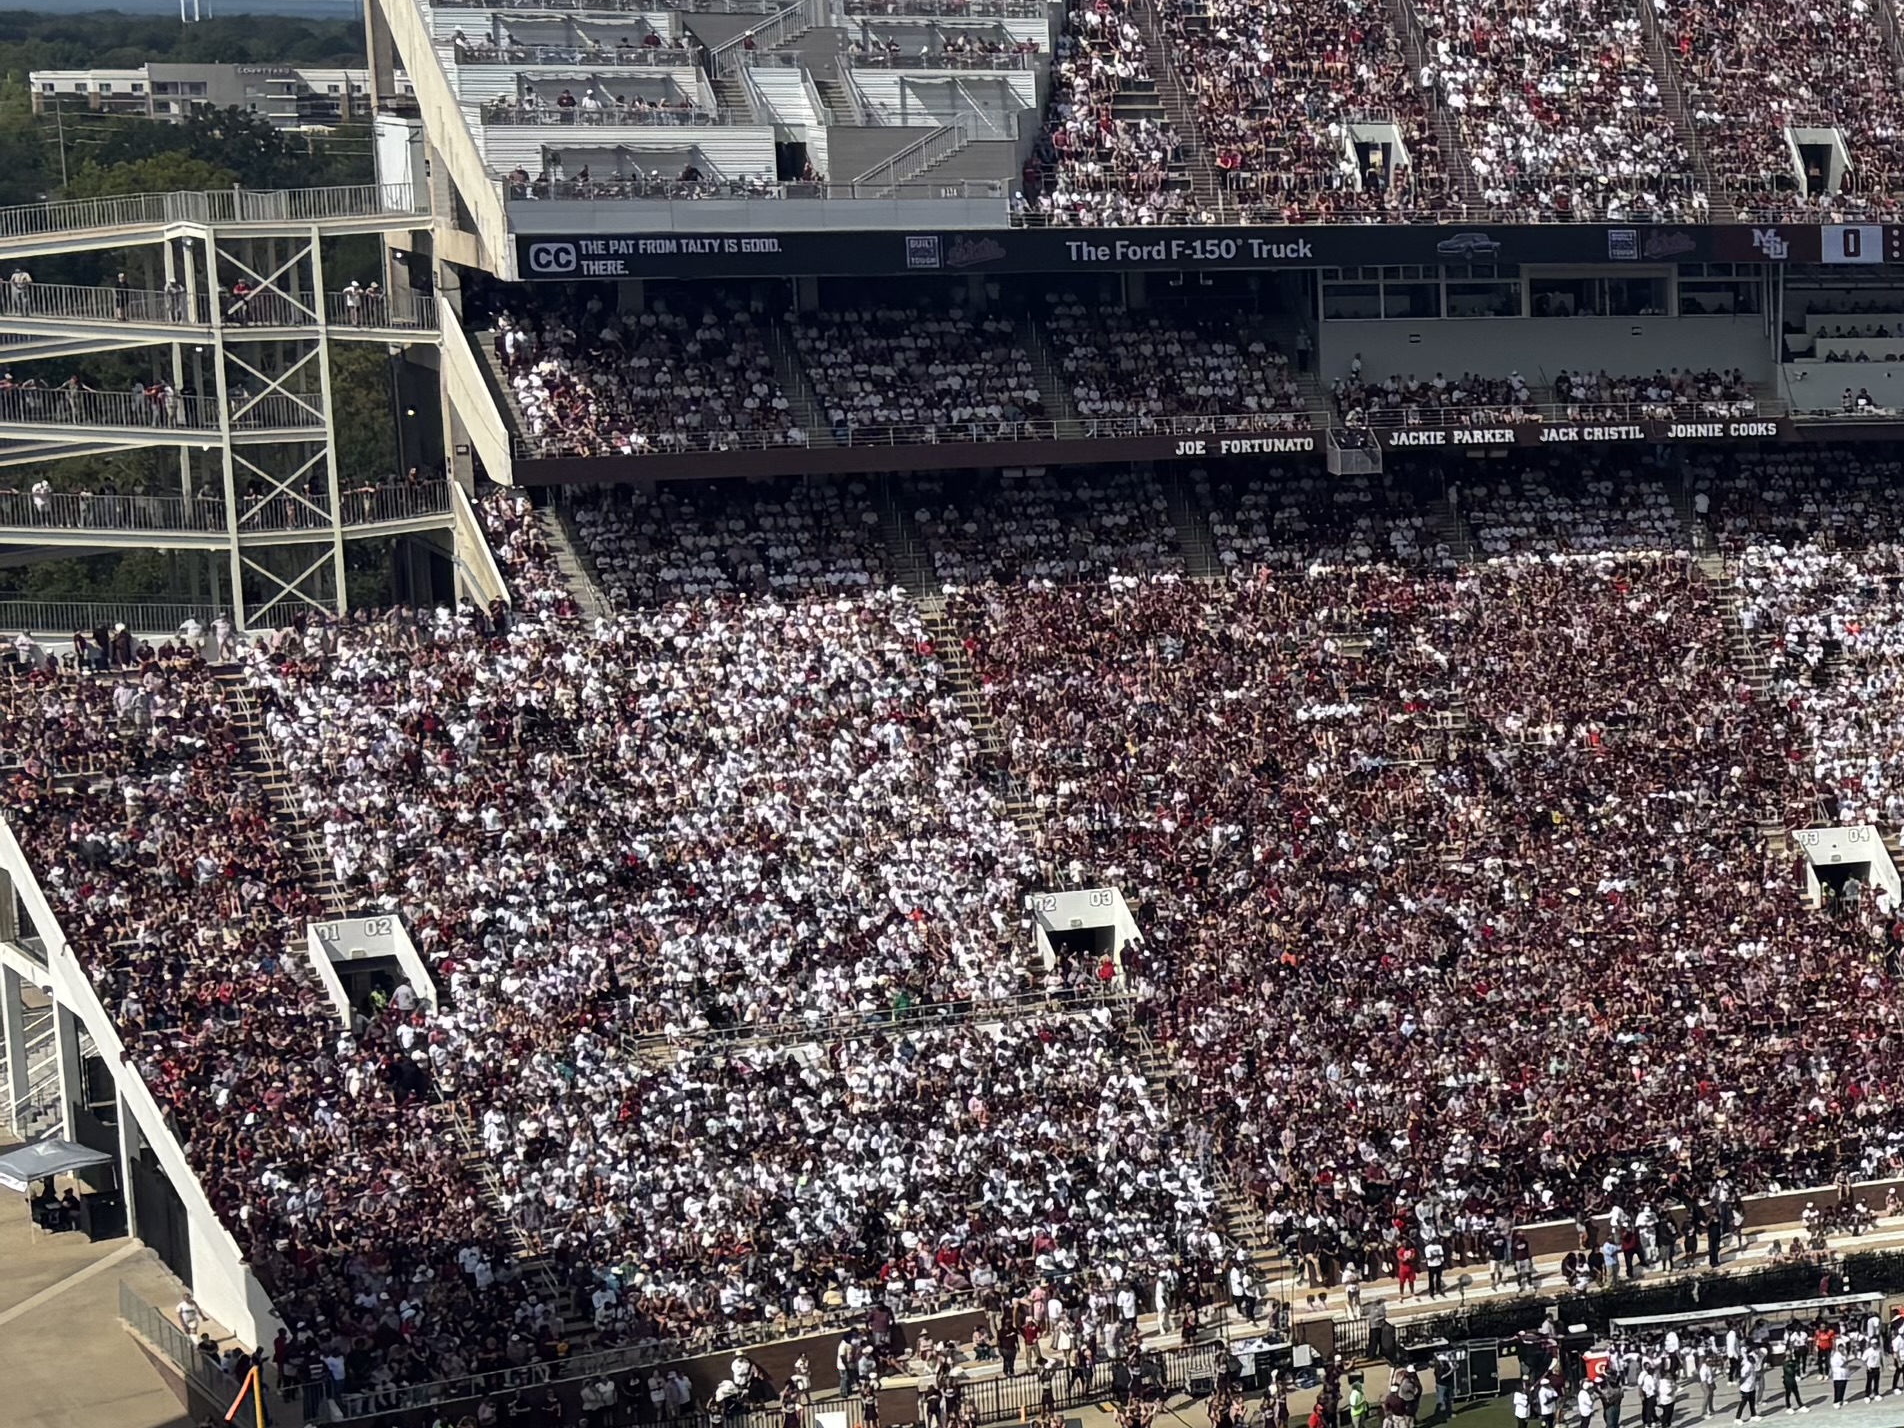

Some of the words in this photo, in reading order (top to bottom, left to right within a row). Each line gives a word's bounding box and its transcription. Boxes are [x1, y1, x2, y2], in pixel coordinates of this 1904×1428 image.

[1065, 240, 1111, 261] The
[1115, 240, 1167, 260] Ford
[1248, 239, 1313, 259] Truck
[1843, 228, 1861, 258] 0
[532, 245, 575, 269] CC
[579, 239, 606, 255] THE
[609, 239, 635, 255] PAT
[638, 239, 678, 254] FROM
[680, 238, 721, 253] TALTY
[724, 238, 738, 253] IS
[581, 259, 629, 275] THERE.
[1388, 430, 1446, 446] JACKIE
[1452, 428, 1515, 444] PARKER
[1539, 426, 1579, 442] JACK
[1583, 425, 1645, 441] CRISTIL
[1667, 423, 1724, 439] JOHNIE
[1729, 422, 1777, 437] COOKS
[1175, 440, 1207, 456] JOE
[1220, 438, 1315, 455] FORTUNATO
[1849, 828, 1871, 843] 04
[1090, 891, 1113, 907] 03
[318, 925, 339, 942] 01
[366, 917, 392, 936] 02
